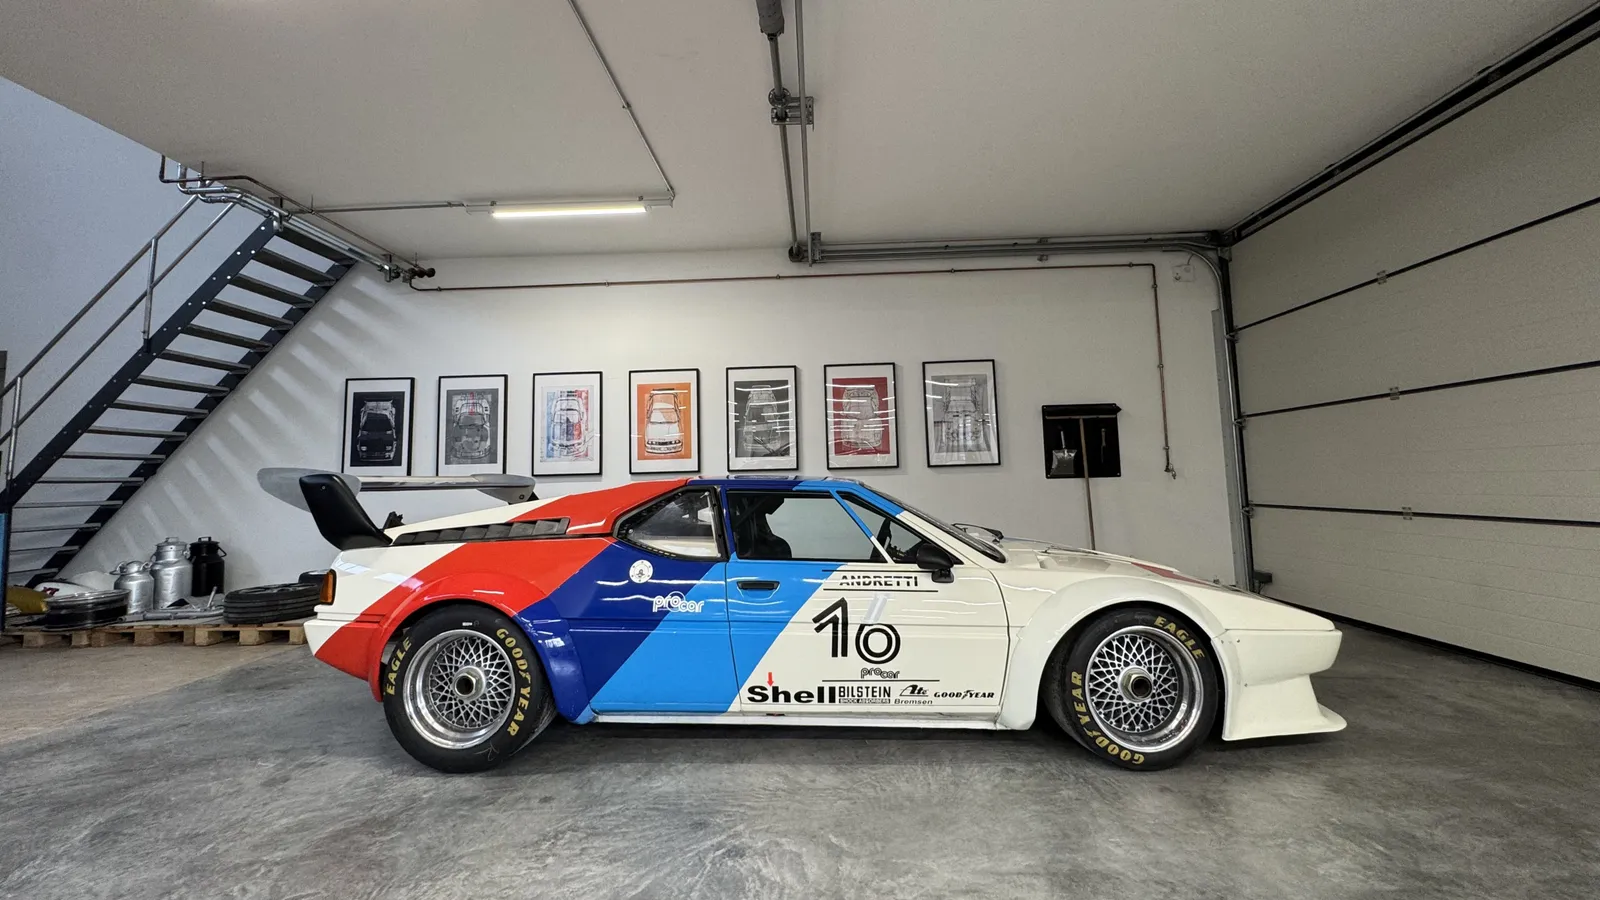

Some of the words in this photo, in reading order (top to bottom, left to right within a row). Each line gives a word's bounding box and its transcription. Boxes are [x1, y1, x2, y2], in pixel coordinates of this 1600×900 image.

[840, 575, 918, 587] ANDRETTI
[652, 592, 705, 613] procar
[1153, 616, 1205, 659] EAGLE
[386, 637, 412, 695] EAGLE
[860, 667, 900, 679] procar
[747, 685, 836, 704] Shell
[838, 686, 891, 698] BILSTEIN
